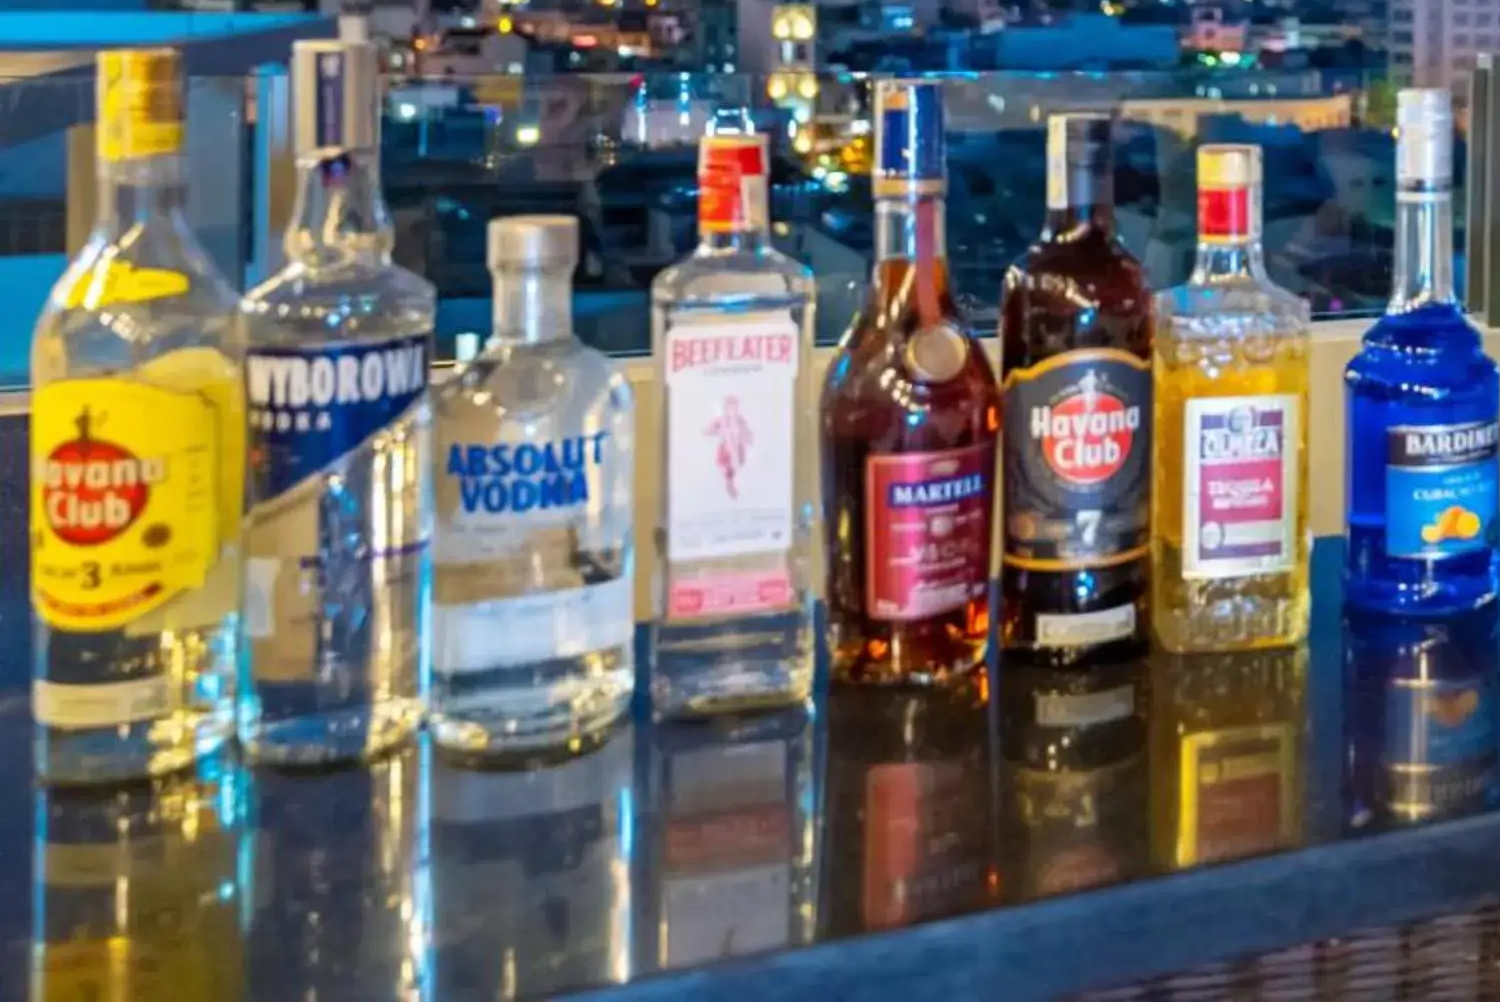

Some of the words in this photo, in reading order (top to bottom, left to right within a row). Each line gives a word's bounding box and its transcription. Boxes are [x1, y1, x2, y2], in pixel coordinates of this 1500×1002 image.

[672, 334, 792, 373] BEEFEATER
[1031, 406, 1140, 439] Havana
[447, 431, 609, 476] ABSOLUT
[1054, 438, 1121, 470] Club
[38, 458, 164, 489] avana
[892, 473, 983, 505] MARTELL
[460, 471, 589, 514] VODKA
[47, 491, 130, 530] Club
[1075, 509, 1103, 545] 7
[80, 561, 102, 591] 3
